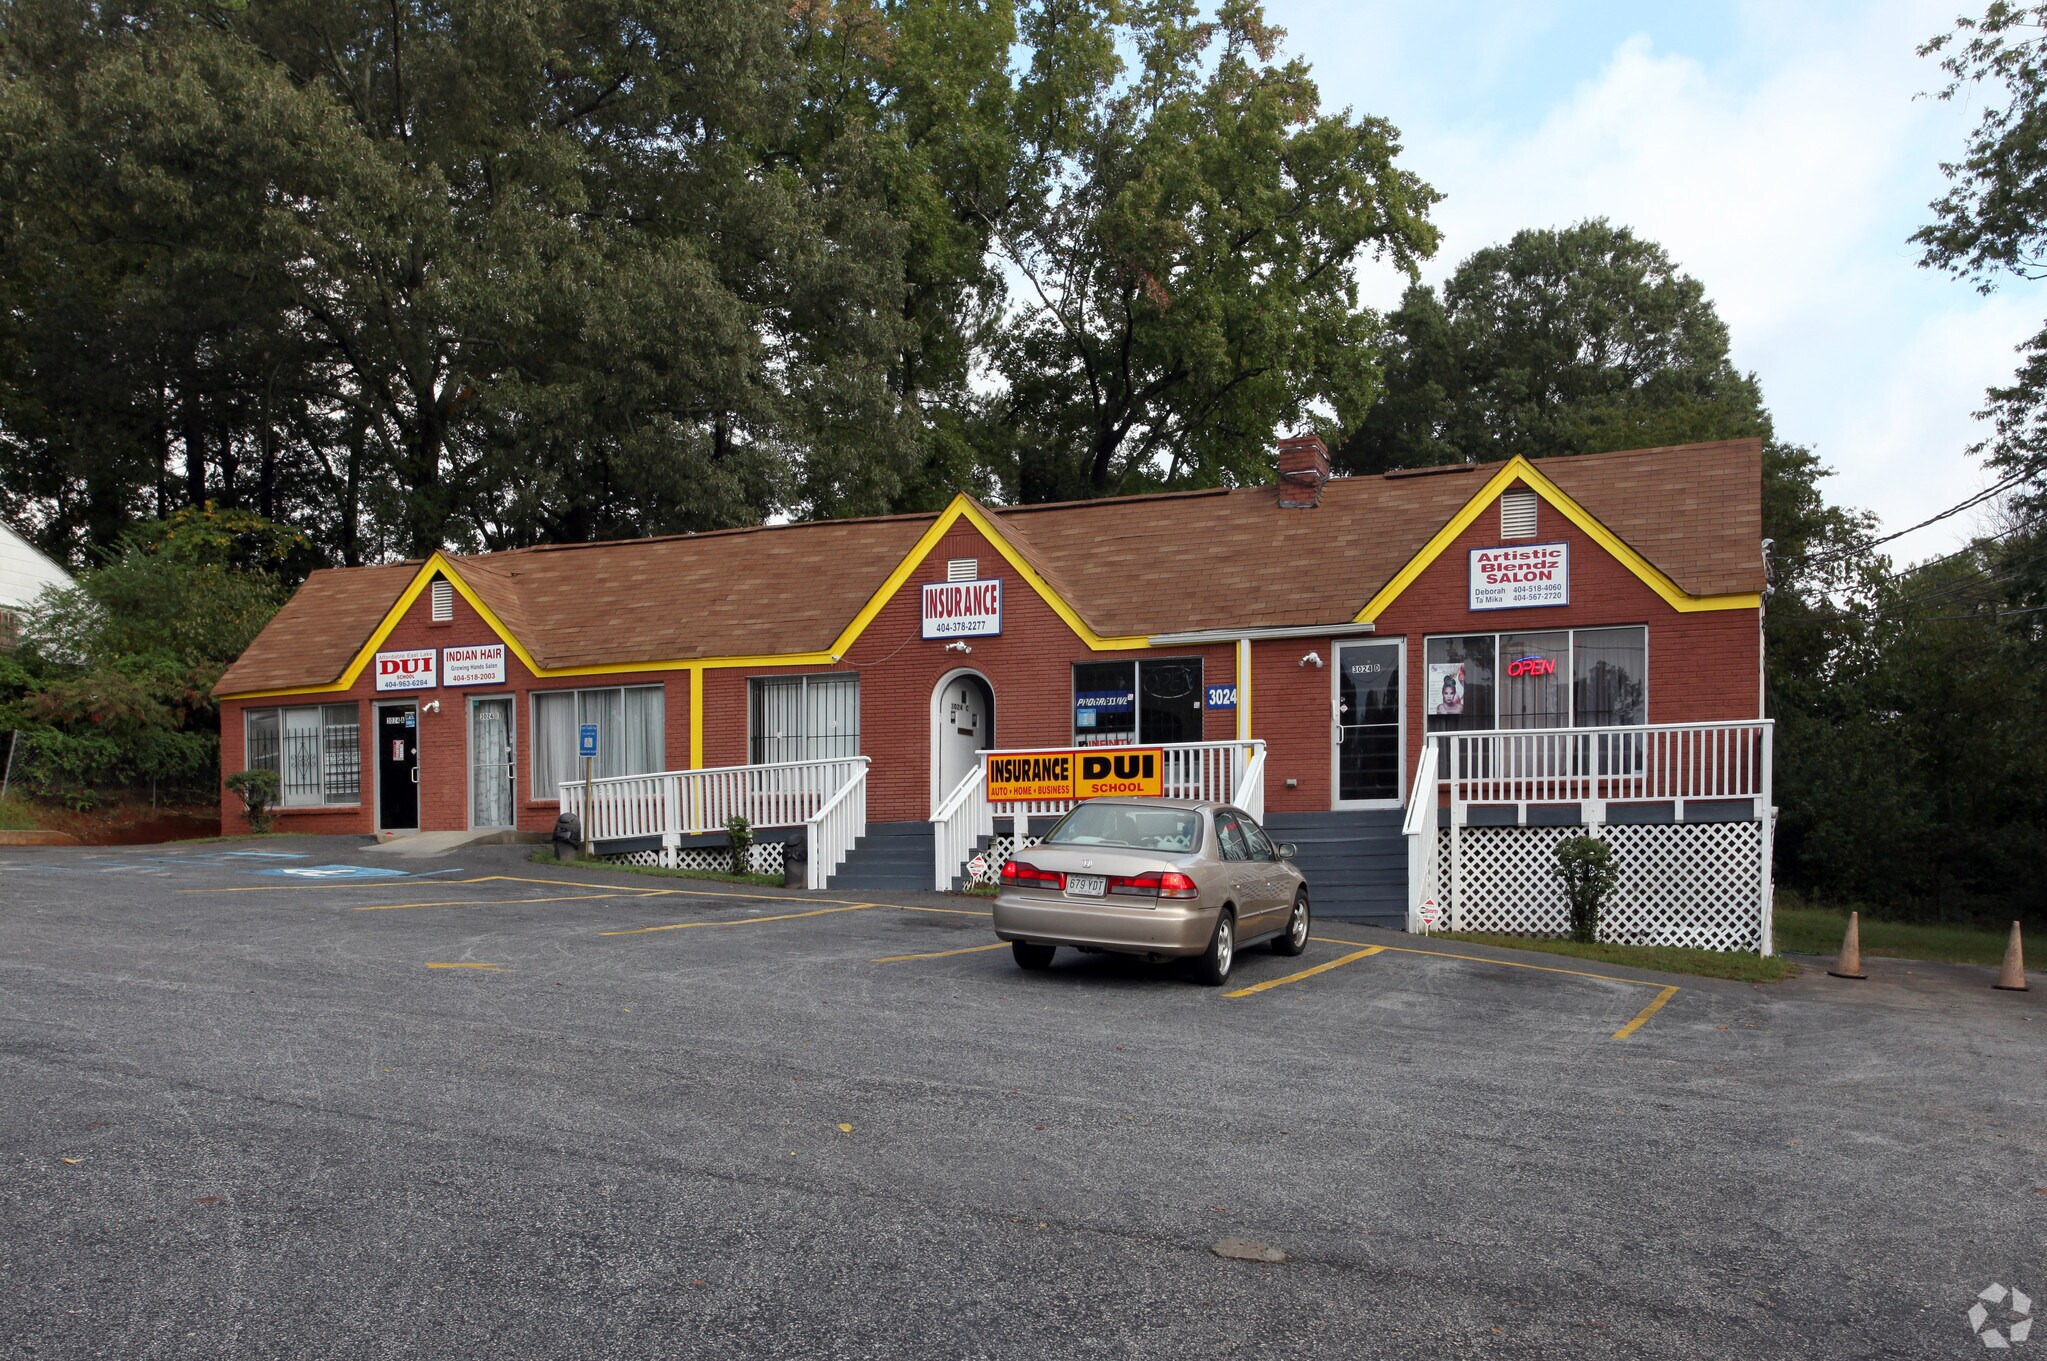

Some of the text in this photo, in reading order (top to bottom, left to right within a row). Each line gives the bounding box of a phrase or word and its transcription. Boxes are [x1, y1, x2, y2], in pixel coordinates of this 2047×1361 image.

[1477, 548, 1562, 563] Artistic
[1481, 560, 1559, 573] Blendz
[1486, 570, 1552, 585] SALON
[1475, 583, 1562, 596] Deborah 404-518-4060
[925, 584, 997, 620] INSURANCE
[1513, 592, 1562, 602] 404-567-2720
[936, 621, 986, 633] 404-378-2277
[446, 648, 502, 662] INDIAN HAIR
[379, 657, 433, 675] DUI
[451, 664, 470, 672] Growing
[470, 663, 485, 671] Hands
[1352, 664, 1373, 673] 3024
[1507, 658, 1556, 677] OPEN
[384, 680, 428, 688] 404-963-6284
[452, 673, 496, 682] 404-518-2003
[1077, 697, 1128, 706] PROGRESSIVE
[1209, 688, 1237, 705] 3024
[990, 757, 1069, 783] INSURANCE
[1082, 754, 1154, 780] DUI
[991, 785, 1070, 796] AUTO HOME BUSINESS
[1091, 782, 1144, 793] SCHOOL
[1070, 878, 1104, 891] 679 YDT
